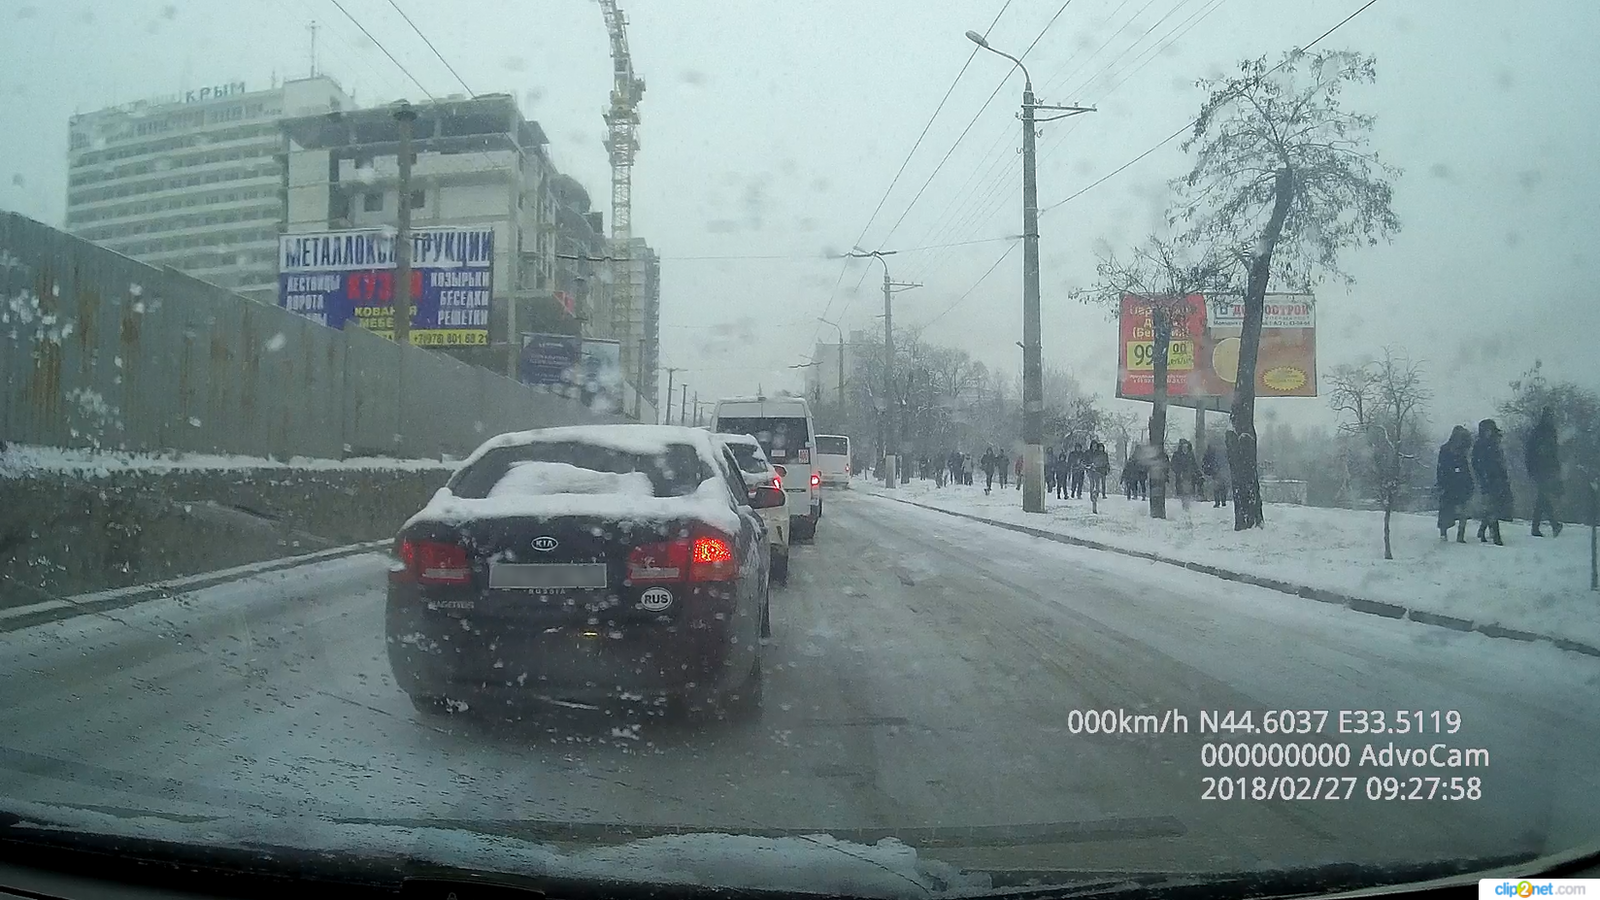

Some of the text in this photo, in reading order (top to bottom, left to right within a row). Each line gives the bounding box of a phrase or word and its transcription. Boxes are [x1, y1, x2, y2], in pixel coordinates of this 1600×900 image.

[185, 82, 245, 103] КРЫМ
[285, 232, 492, 267] МЕТАЛЛОКОНТРУКЦИИ
[287, 274, 341, 292] ЛЕСТНИЦЫ
[430, 272, 490, 287] КОЗЫРЬКИ
[286, 294, 324, 311] ВОРОТА
[440, 290, 489, 308] БЕСЕДКИ
[437, 309, 488, 326] РЕШЕТКИ
[534, 539, 555, 548] KIA
[644, 594, 669, 605] RUS
